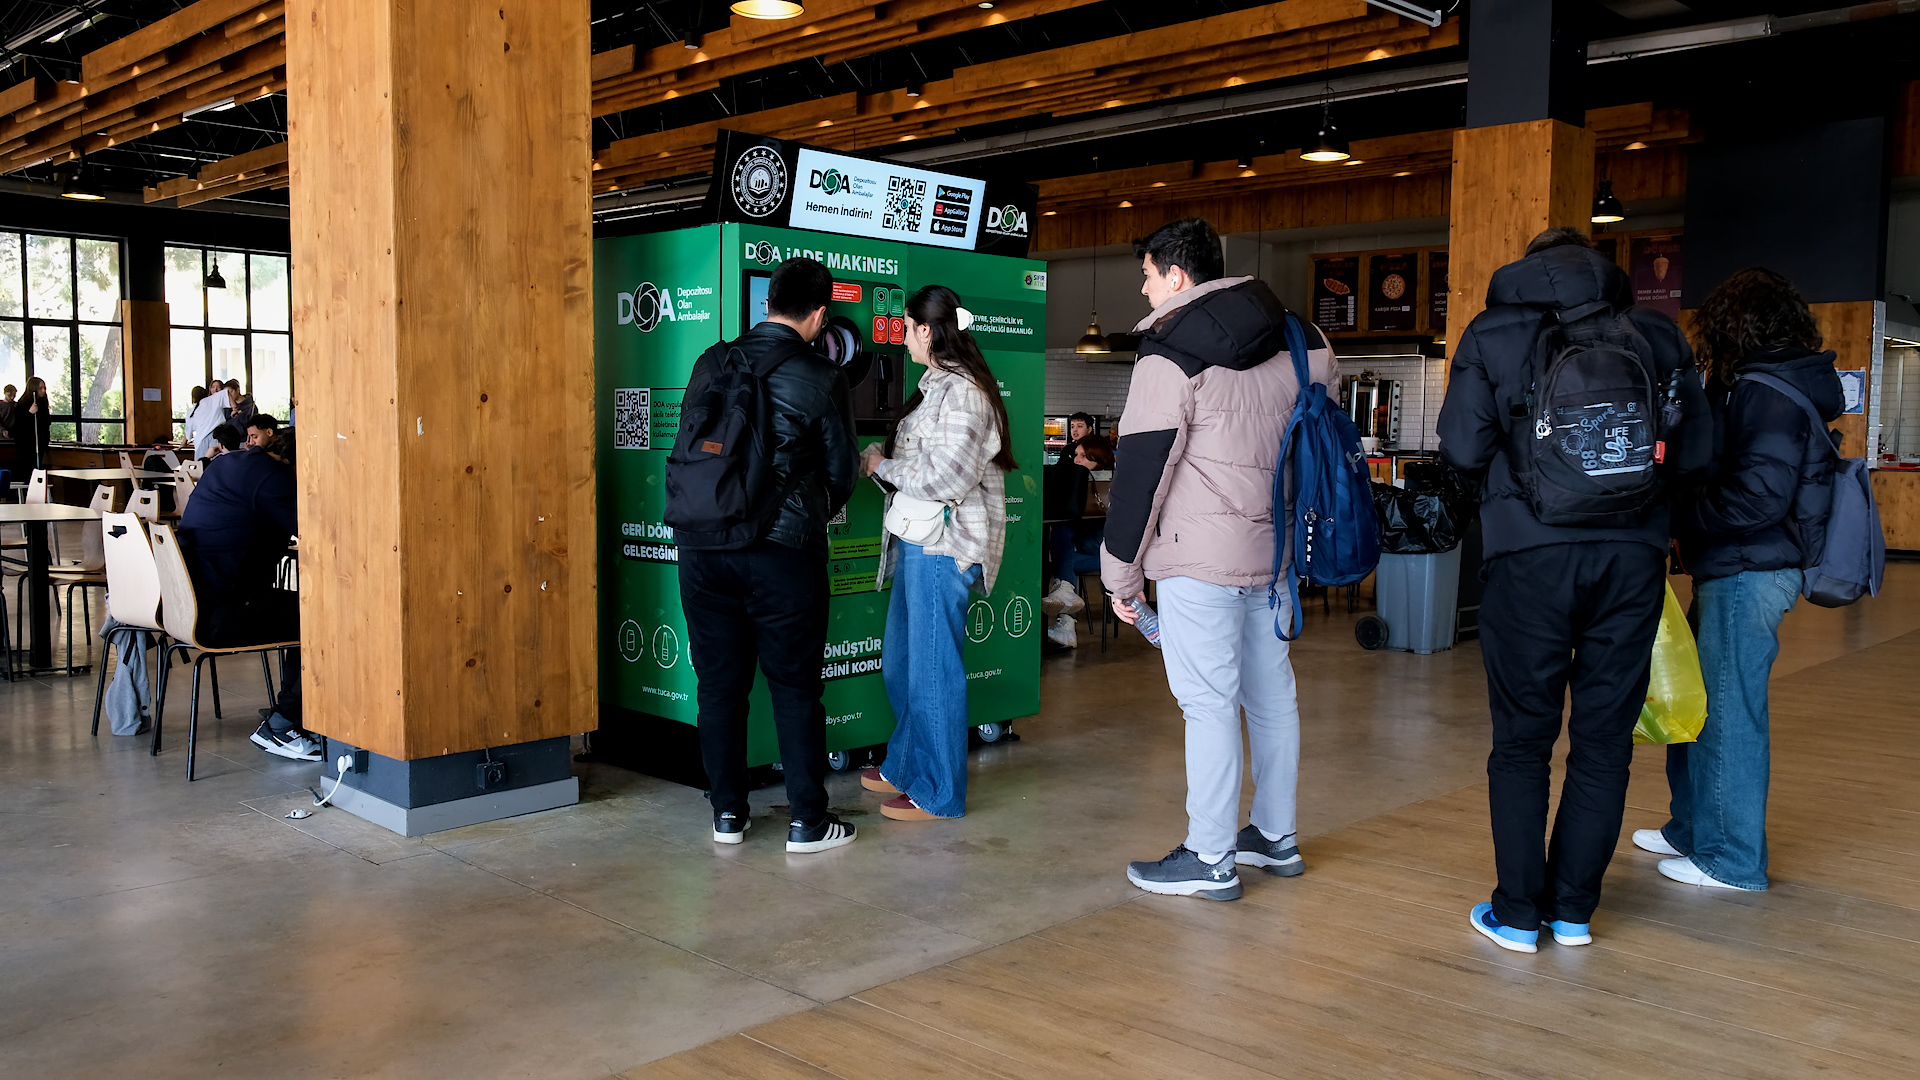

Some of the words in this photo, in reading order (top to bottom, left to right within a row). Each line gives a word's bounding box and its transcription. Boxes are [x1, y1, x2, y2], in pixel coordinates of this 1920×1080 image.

[809, 168, 850, 195] DOA
[946, 190, 962, 199] Google
[961, 192, 970, 201] Play
[806, 201, 839, 215] Hemen
[944, 207, 967, 217] AppGallery
[987, 204, 1028, 232] DOA
[941, 224, 951, 233] App
[951, 225, 963, 233] Store
[745, 240, 782, 265] DOA
[677, 286, 712, 298] Depozitosu
[617, 281, 677, 332] DOA
[677, 300, 692, 309] Olan
[677, 310, 711, 322] Ambalajlar
[666, 401, 682, 410] uygula
[653, 430, 676, 440] kullanmay
[1604, 426, 1629, 438] LIFE
[621, 521, 645, 537] GERİ
[834, 527, 841, 535] 4.
[623, 544, 679, 561] GELECEĞİNİ
[834, 565, 841, 573] 5.
[823, 636, 882, 658] ÖNÜŞTÜR
[851, 658, 882, 674] KORU
[641, 685, 689, 701] www.tuca.gov.tr
